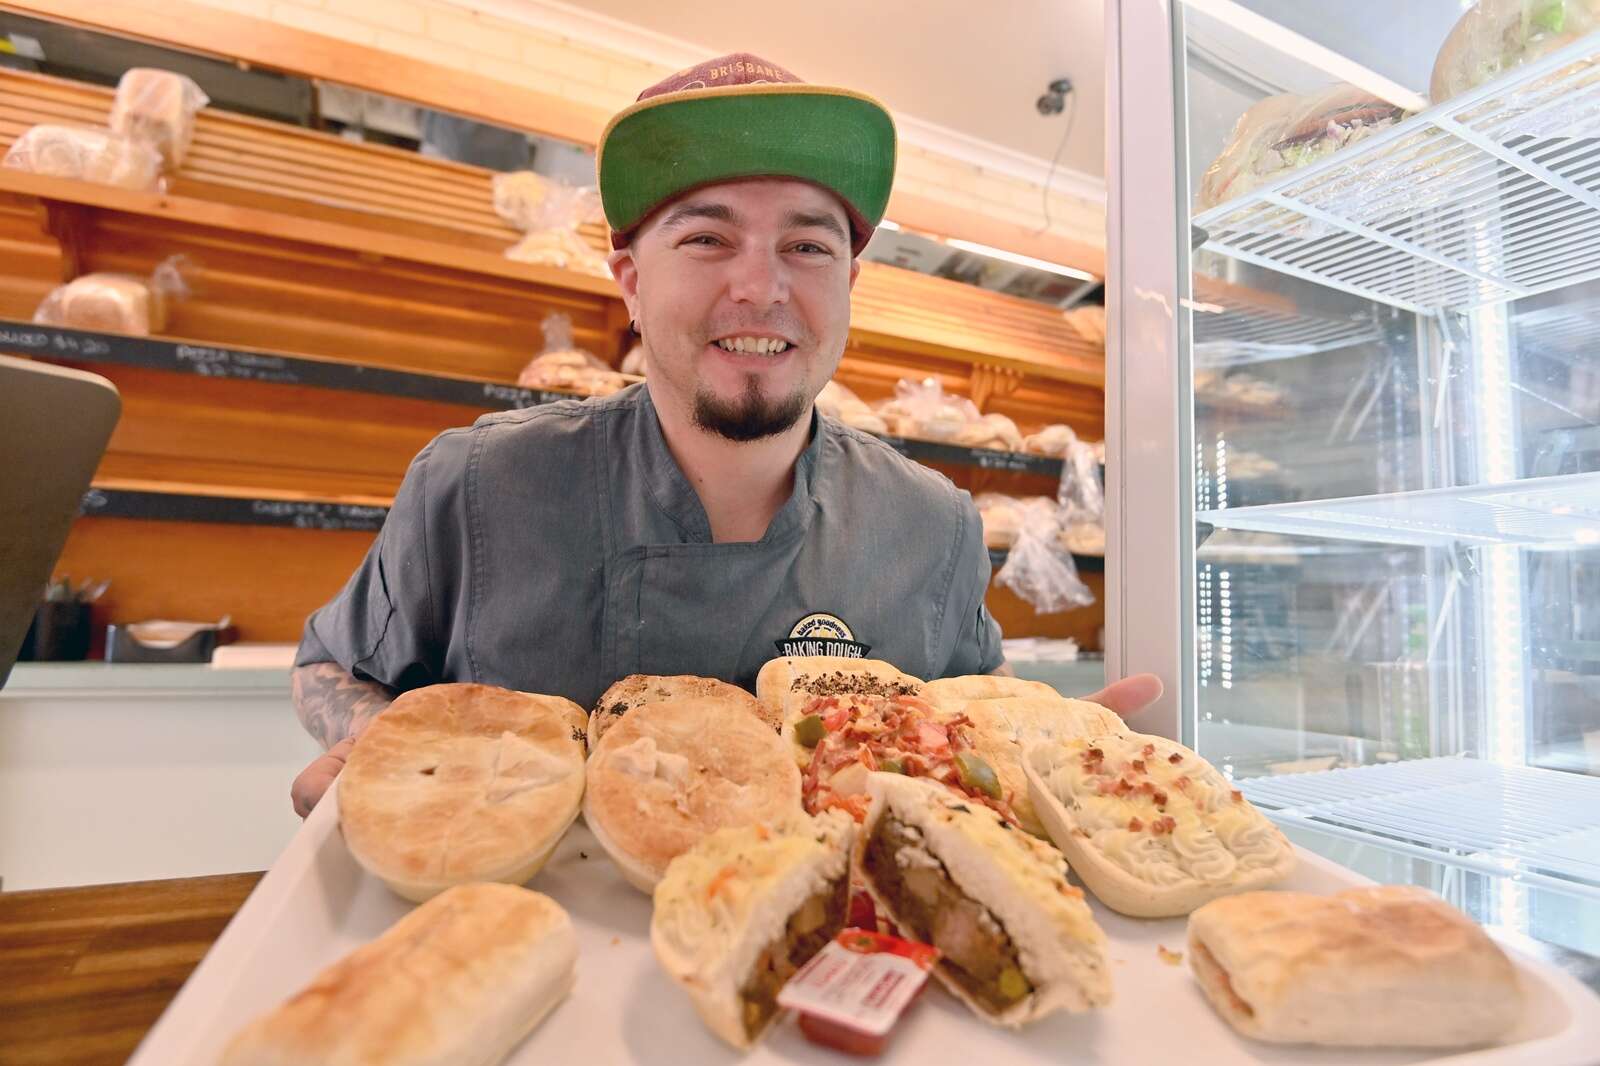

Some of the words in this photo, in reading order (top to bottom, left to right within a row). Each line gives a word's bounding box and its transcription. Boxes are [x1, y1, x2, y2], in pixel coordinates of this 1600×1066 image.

[710, 61, 783, 80] BRISBANE
[796, 619, 816, 636] baked
[817, 619, 847, 638] goodness
[784, 641, 823, 657] BAKING
[826, 642, 863, 659] DOUGH
